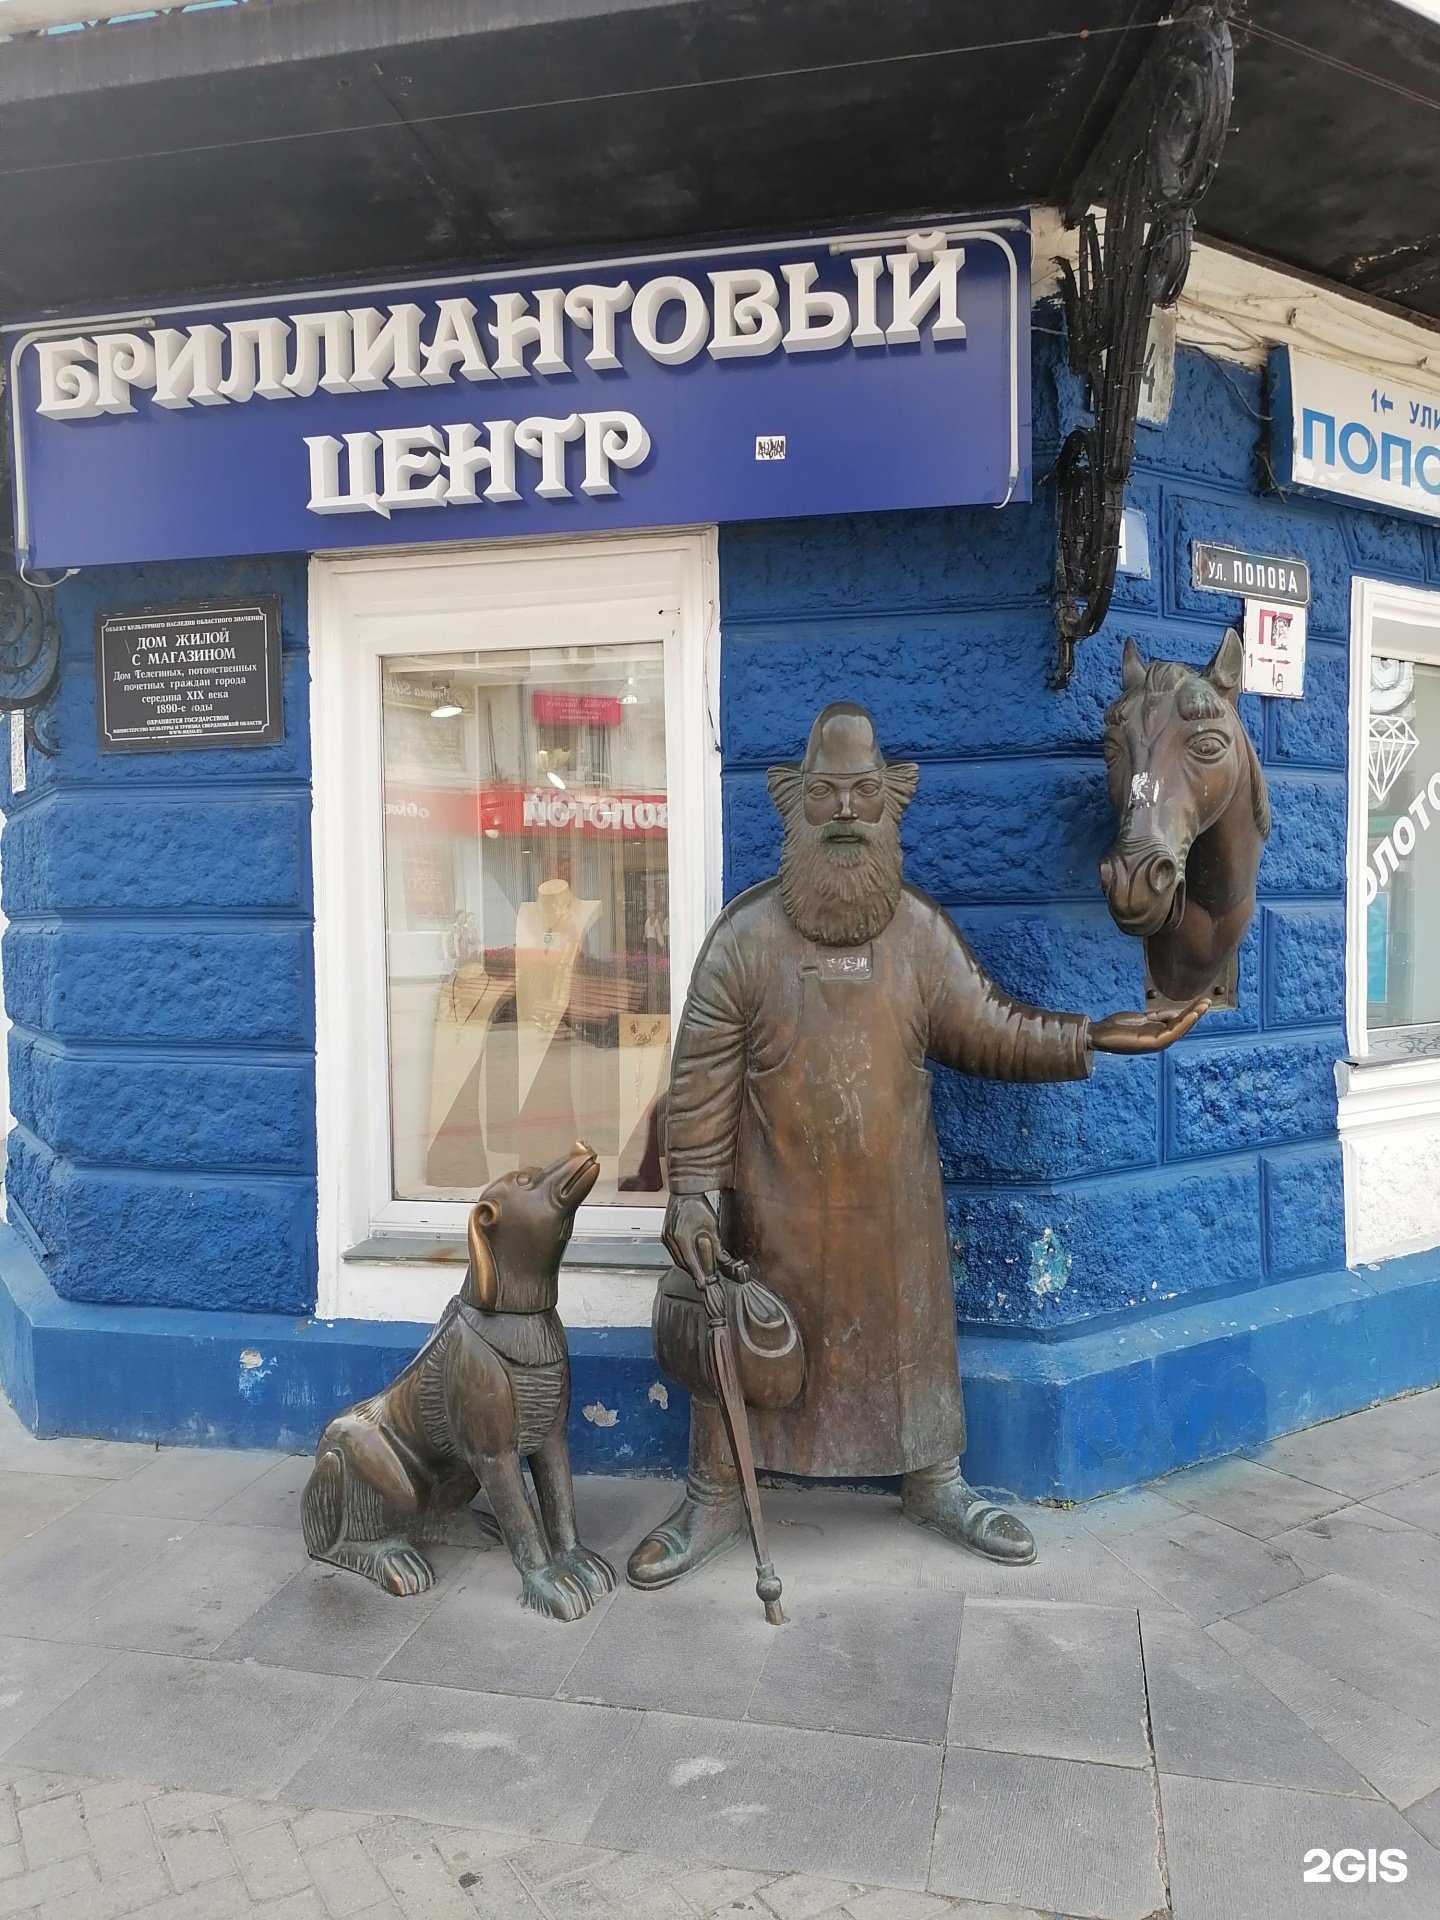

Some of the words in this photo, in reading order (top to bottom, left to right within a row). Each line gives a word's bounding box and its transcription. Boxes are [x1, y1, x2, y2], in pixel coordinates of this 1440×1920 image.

[33, 231, 967, 421] БРИЛЛИАНТОВЫЙ
[303, 411, 652, 519] ЦЕНТР
[1233, 560, 1298, 593] ПОПОВА
[136, 635, 167, 651] ДОМ
[175, 627, 230, 647] ЖИЛОЙ
[131, 653, 141, 666] С
[147, 647, 236, 665] МАГАЗИНОМ
[113, 671, 131, 682] Дом
[188, 664, 257, 676] потомственных
[123, 681, 165, 692] почетных
[170, 679, 211, 691] граждан
[215, 676, 247, 687] города
[141, 694, 182, 705] середина
[186, 690, 205, 701] XIX
[208, 691, 229, 699] века
[156, 703, 187, 714] 1890-е
[191, 703, 213, 712] годы
[184, 715, 230, 724] ГОСУДАРСТВОМ
